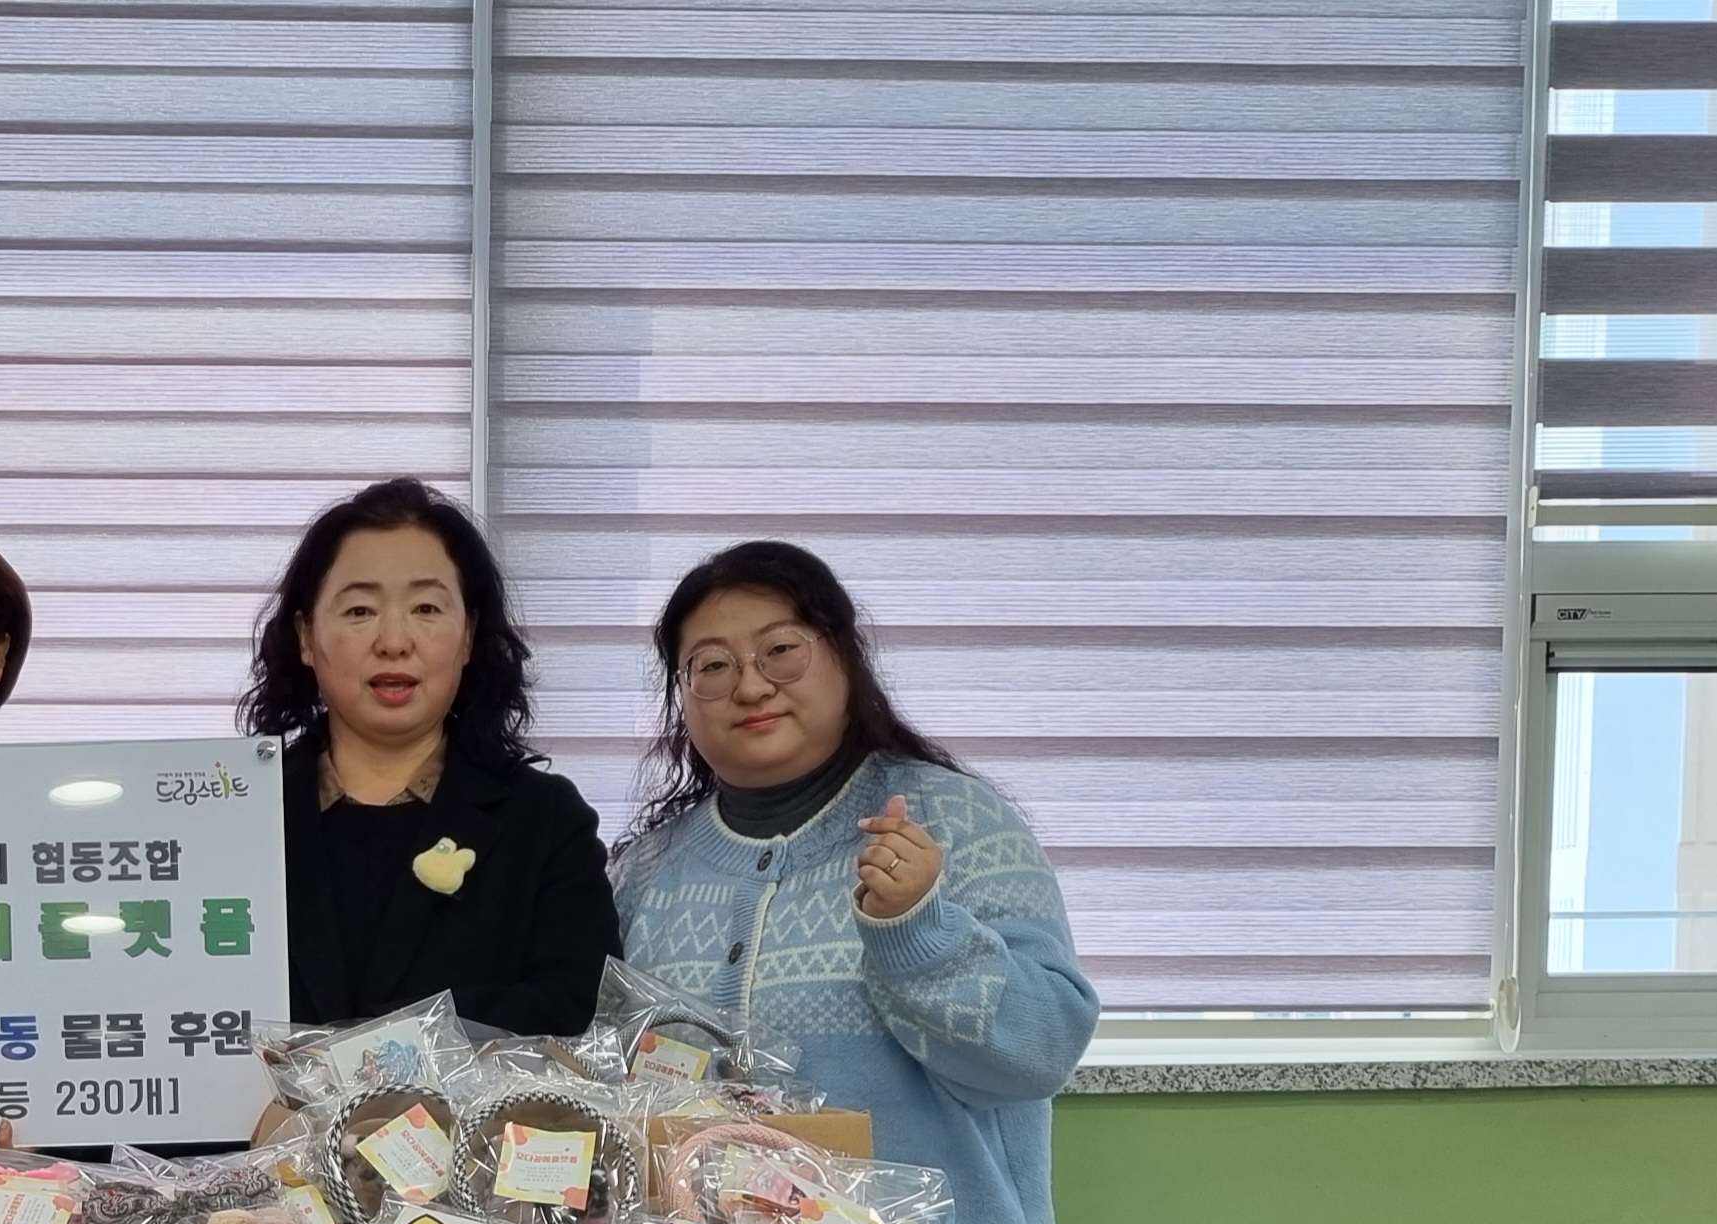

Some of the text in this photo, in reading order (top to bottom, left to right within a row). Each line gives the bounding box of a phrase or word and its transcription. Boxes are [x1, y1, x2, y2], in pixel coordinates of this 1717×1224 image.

[1557, 608, 1586, 620] CITY
[156, 776, 249, 805] 드림스타트
[32, 840, 181, 884] 협동조합
[61, 1012, 146, 1060] 물품
[169, 1010, 252, 1056] 후원
[56, 1077, 180, 1116] 230개]
